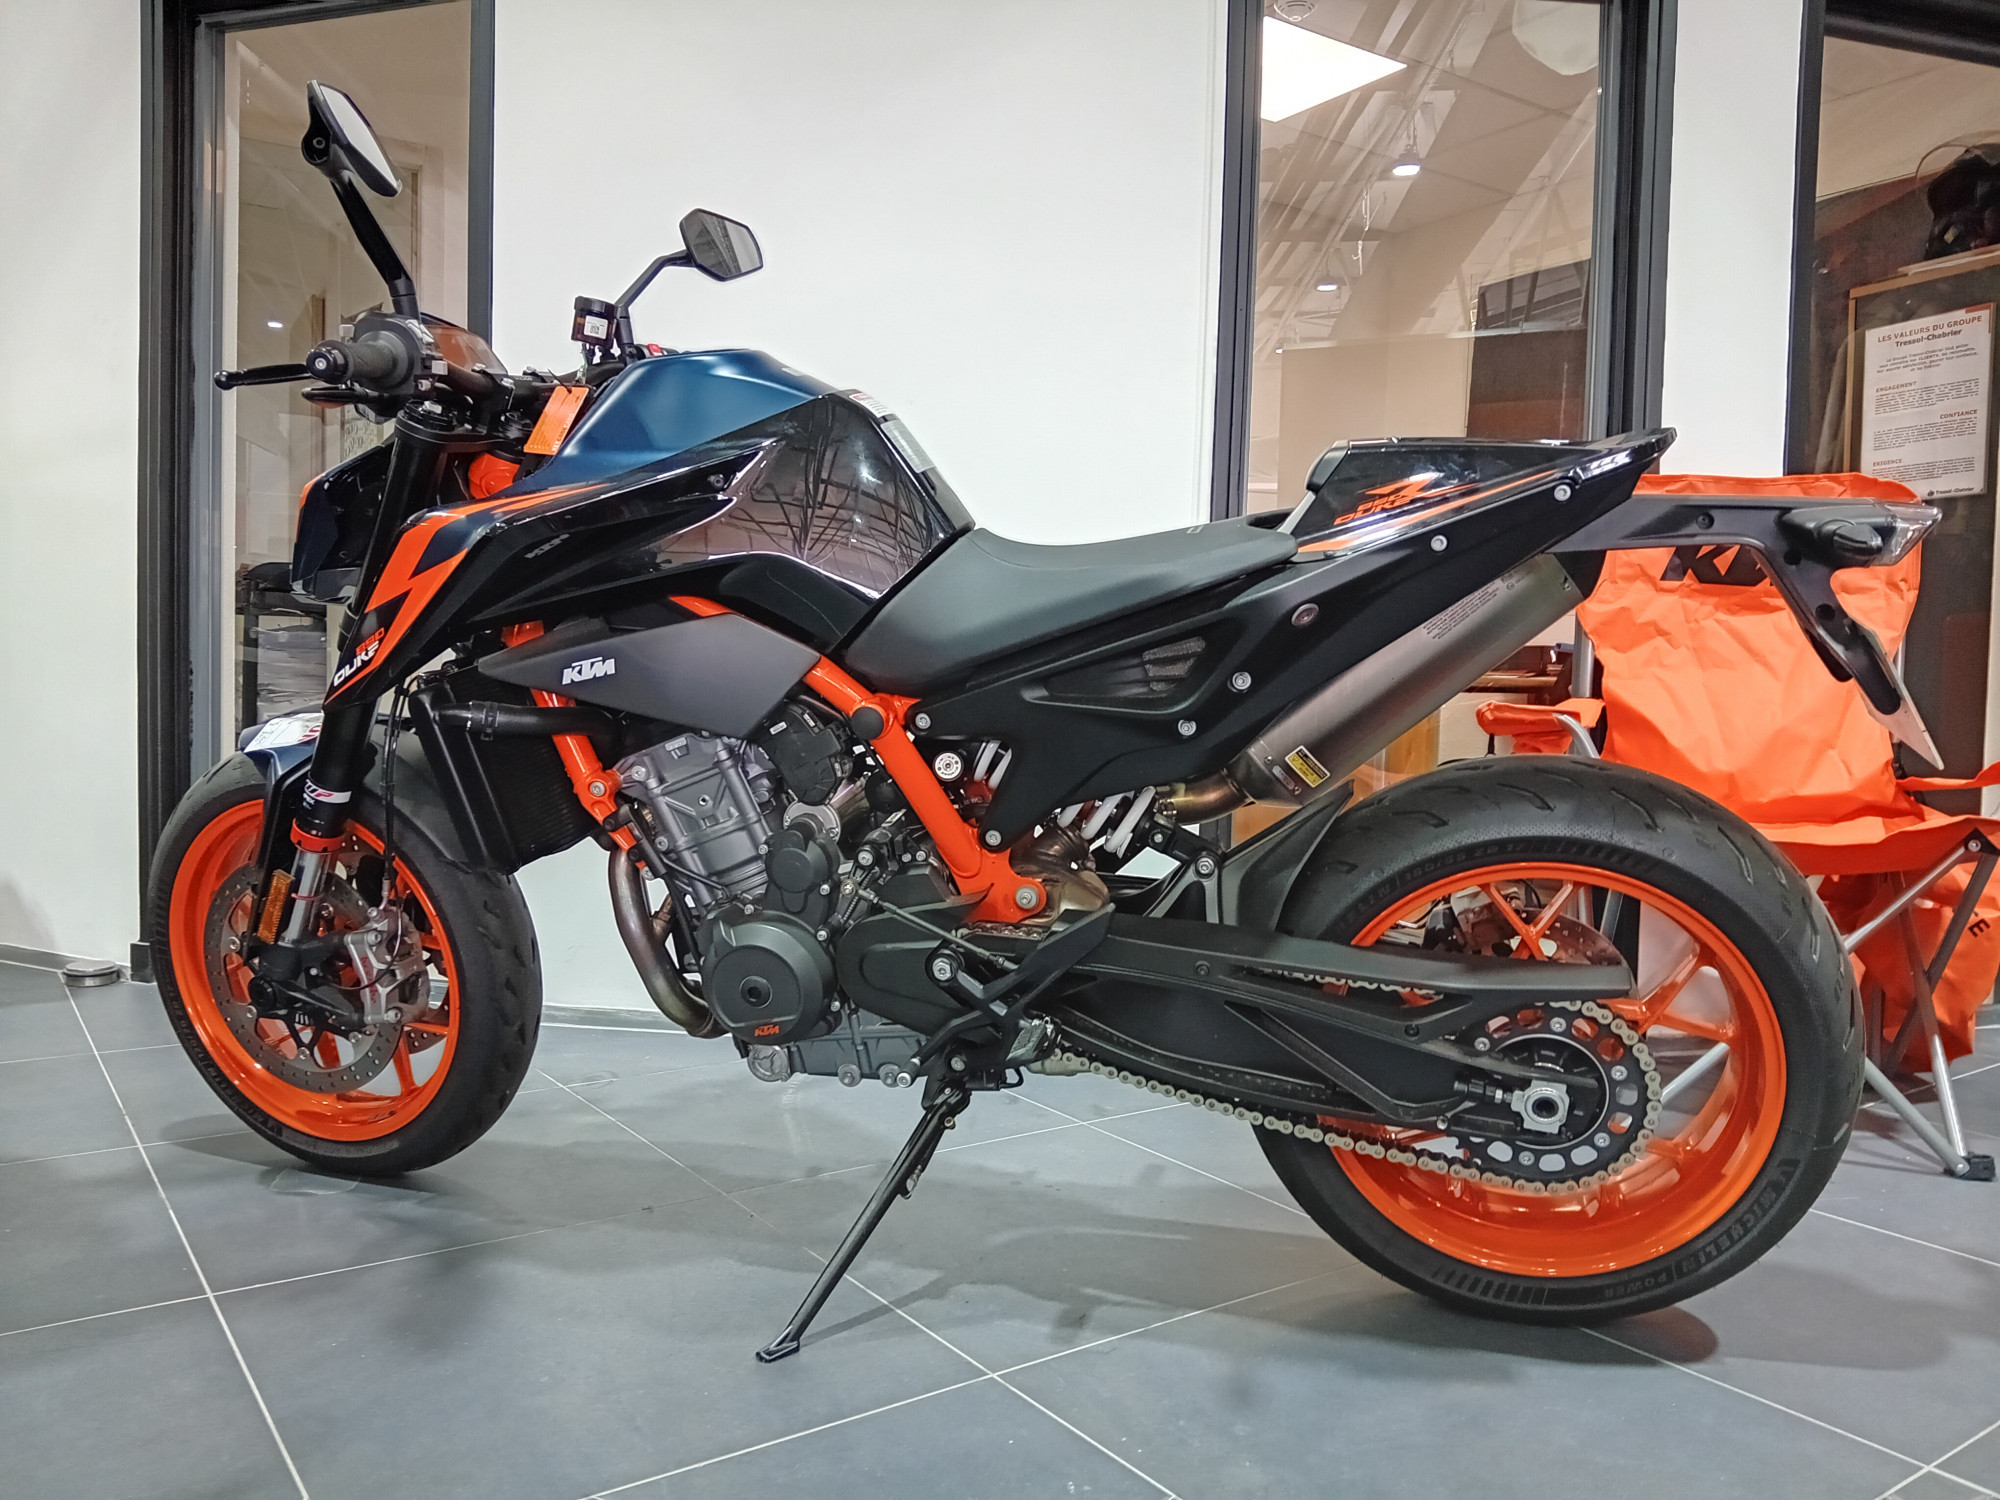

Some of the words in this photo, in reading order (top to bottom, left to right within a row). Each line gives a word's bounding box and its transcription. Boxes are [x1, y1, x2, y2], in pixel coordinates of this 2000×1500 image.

[1877, 334, 1892, 343] LES
[1894, 326, 1931, 339] VALEURS
[1932, 323, 1945, 332] DU
[1947, 315, 1983, 329] GROUPE
[1895, 329, 1963, 348] Tressol-Chabrier
[1876, 381, 1917, 393] ENGAGEMENT
[1939, 409, 1978, 419] CONFIANCE
[1873, 458, 1902, 467] EXIGENCE
[1333, 497, 1411, 526] DUKE
[333, 641, 380, 687] DUKE
[562, 656, 616, 685] KTM
[754, 1024, 780, 1037] KTM
[1681, 1184, 1778, 1273] MICHELIN
